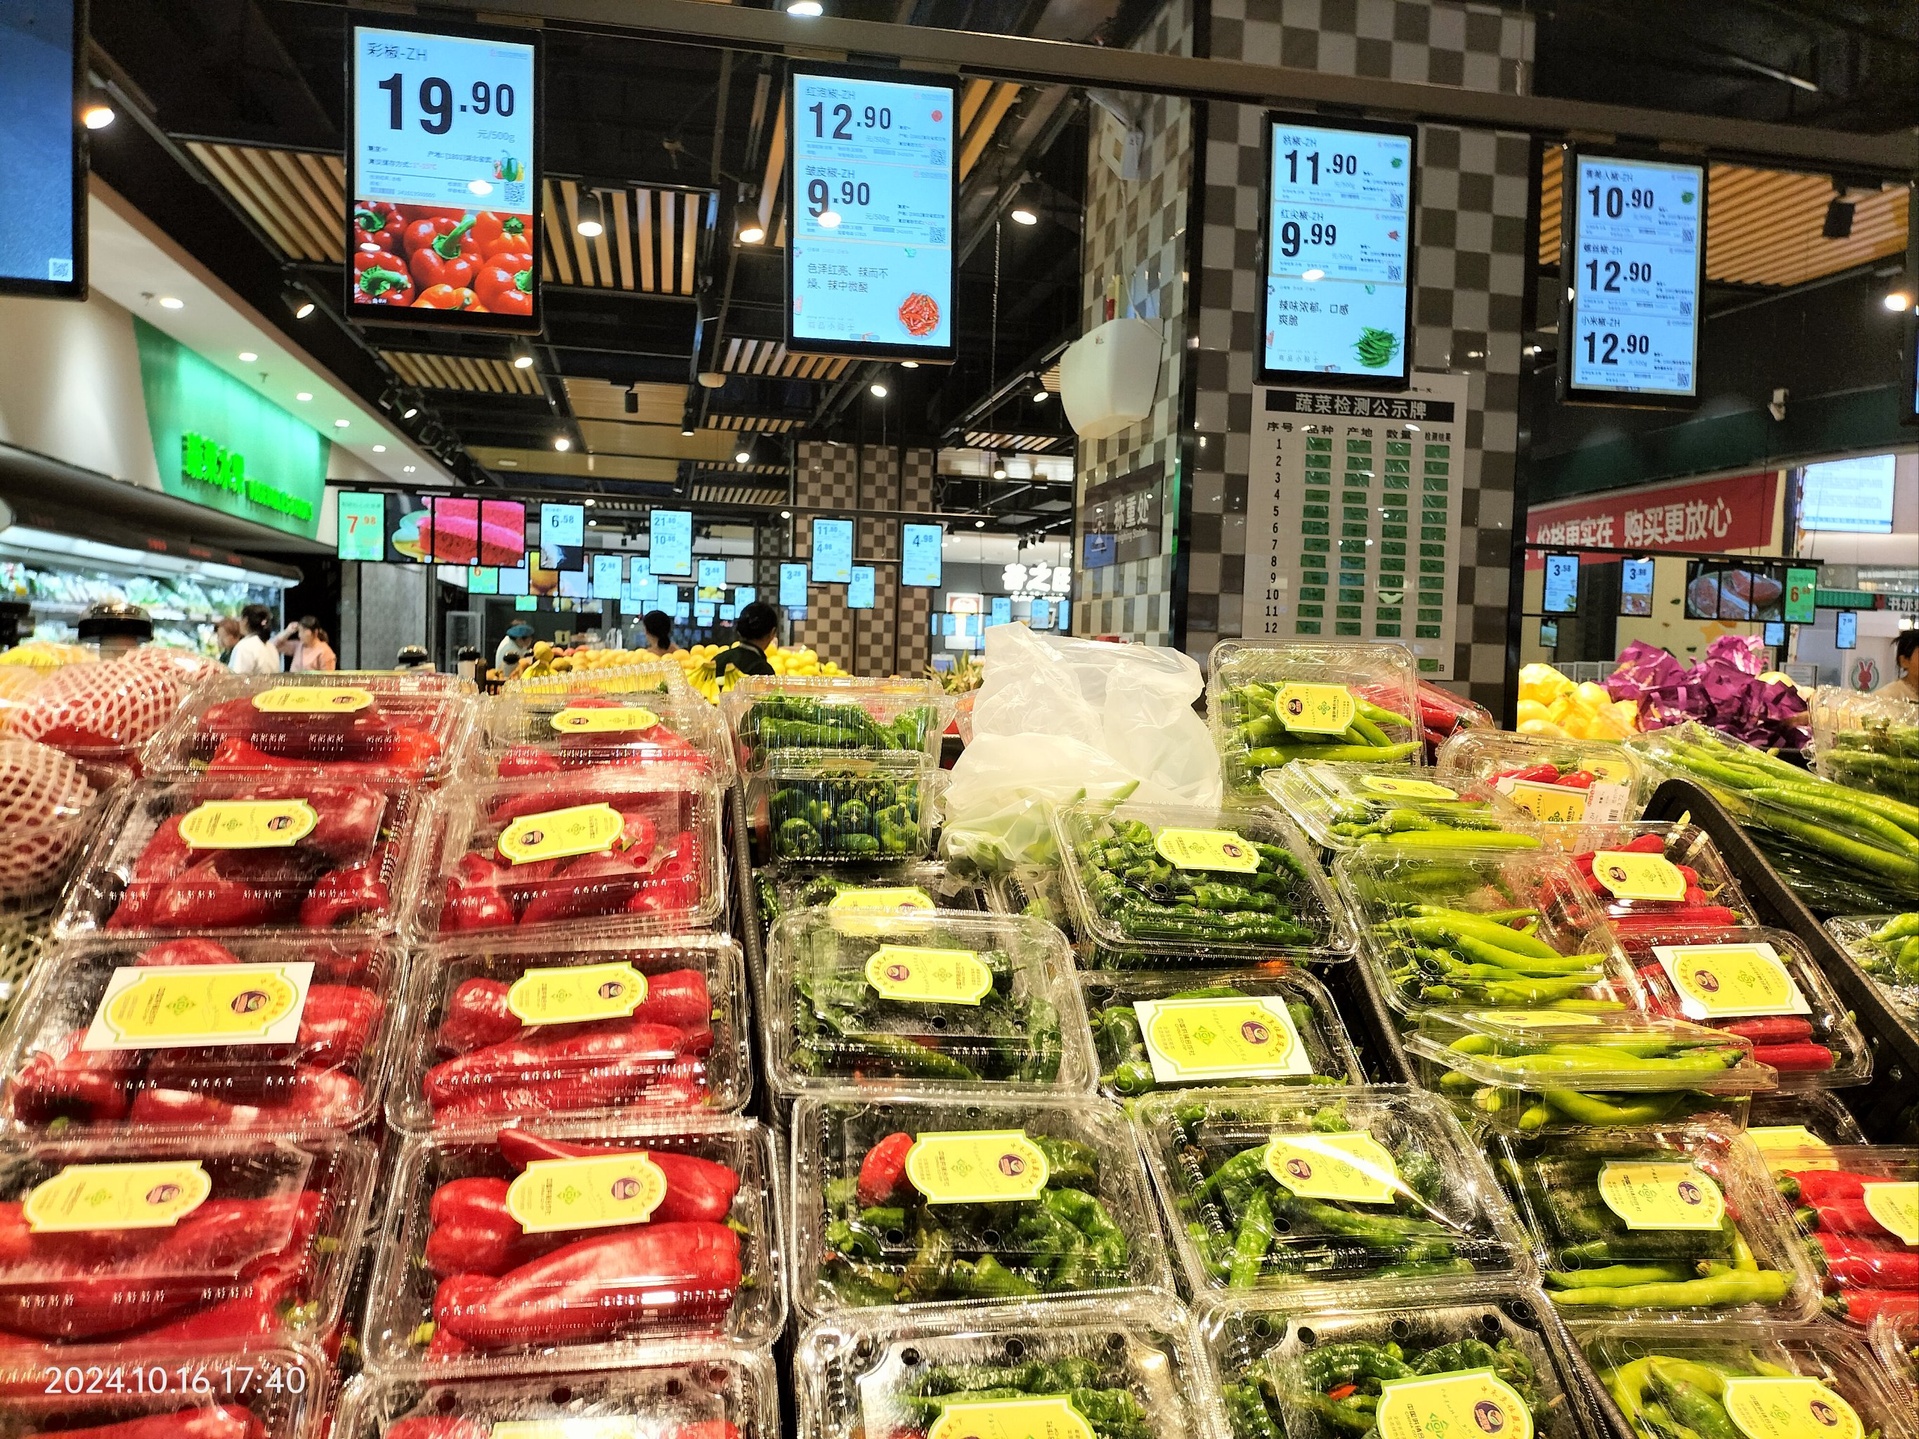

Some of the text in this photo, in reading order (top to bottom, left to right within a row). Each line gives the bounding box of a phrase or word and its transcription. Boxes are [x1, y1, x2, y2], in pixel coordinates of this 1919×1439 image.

[378, 73, 514, 134] 19.90
[808, 102, 891, 140] 12.90
[1285, 150, 1357, 186] 11.90
[807, 178, 870, 218] 9.90
[1588, 185, 1654, 218] 10.90
[1282, 222, 1336, 258] 9.99
[1586, 259, 1652, 294] 12.90
[1584, 332, 1650, 366] 12.90
[1296, 393, 1426, 420] 蔬菜检测公示牌
[1266, 421, 1294, 432] 序号
[1306, 424, 1334, 434] 品种
[1346, 426, 1373, 438] 产地
[1386, 429, 1412, 440] 数量
[1276, 439, 1282, 450] 1
[1276, 456, 1282, 466] 2
[1274, 473, 1281, 484] 3
[1274, 490, 1280, 500] 4
[1114, 492, 1149, 530] 称重处
[1273, 506, 1279, 517] 5
[552, 514, 574, 528] 6.58
[1624, 497, 1732, 548] 购买更放心
[1272, 523, 1278, 534] 6
[912, 534, 934, 547] 4.98
[1272, 539, 1278, 550] 7
[1270, 556, 1277, 567] 8
[1270, 572, 1276, 584] 9
[1266, 590, 1279, 600] 10
[1265, 606, 1278, 616] 11
[1264, 622, 1278, 634] 12
